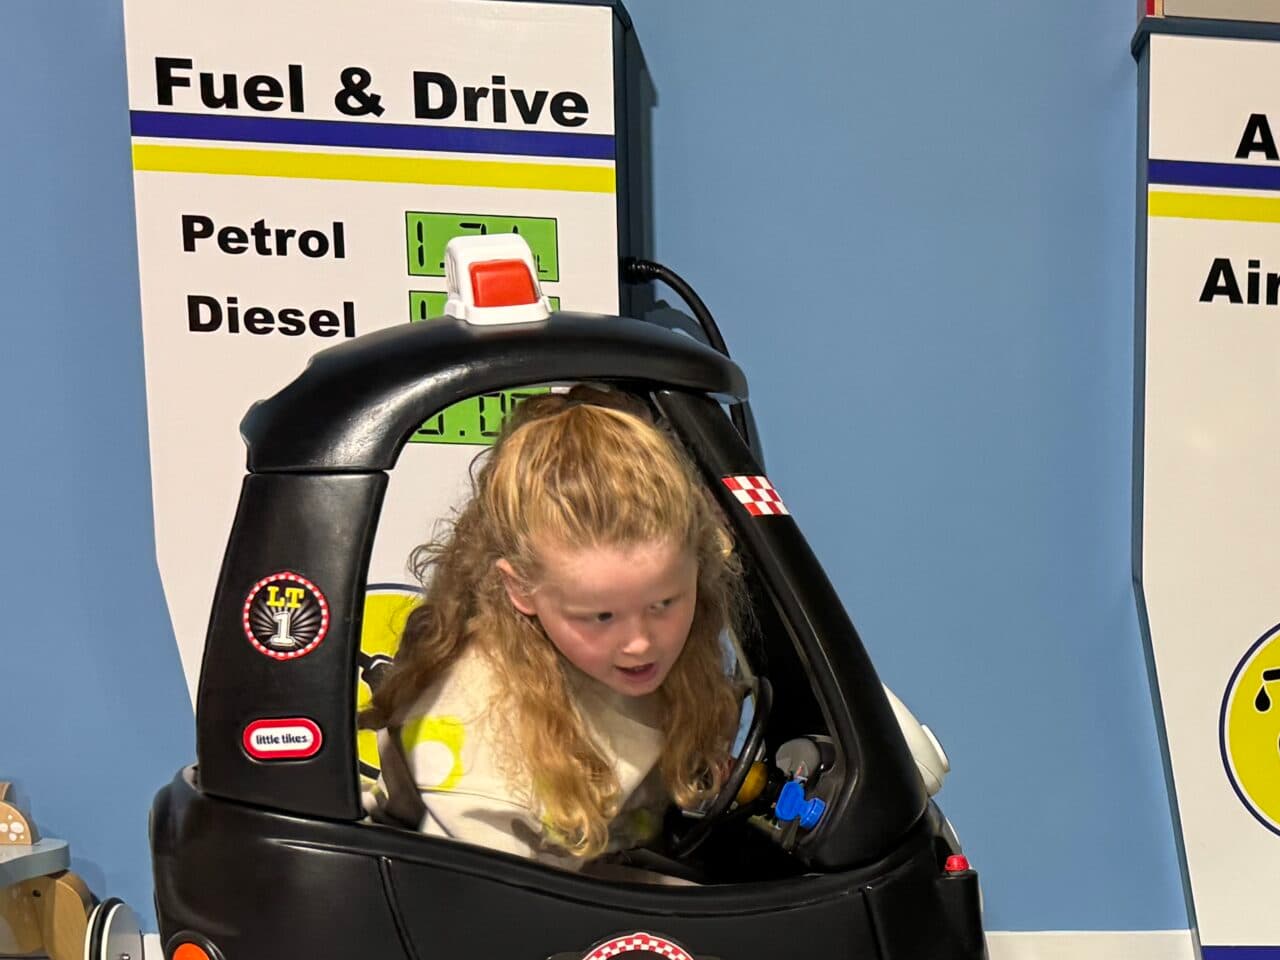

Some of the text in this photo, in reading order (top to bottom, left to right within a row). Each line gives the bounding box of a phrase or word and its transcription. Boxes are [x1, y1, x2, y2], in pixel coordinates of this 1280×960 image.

[155, 57, 589, 127] Fuel & Drive
[181, 215, 346, 259] Petrol
[187, 295, 356, 337] Diesel
[266, 586, 304, 608] LT
[270, 610, 296, 647] 1
[256, 733, 308, 745] little tikes
